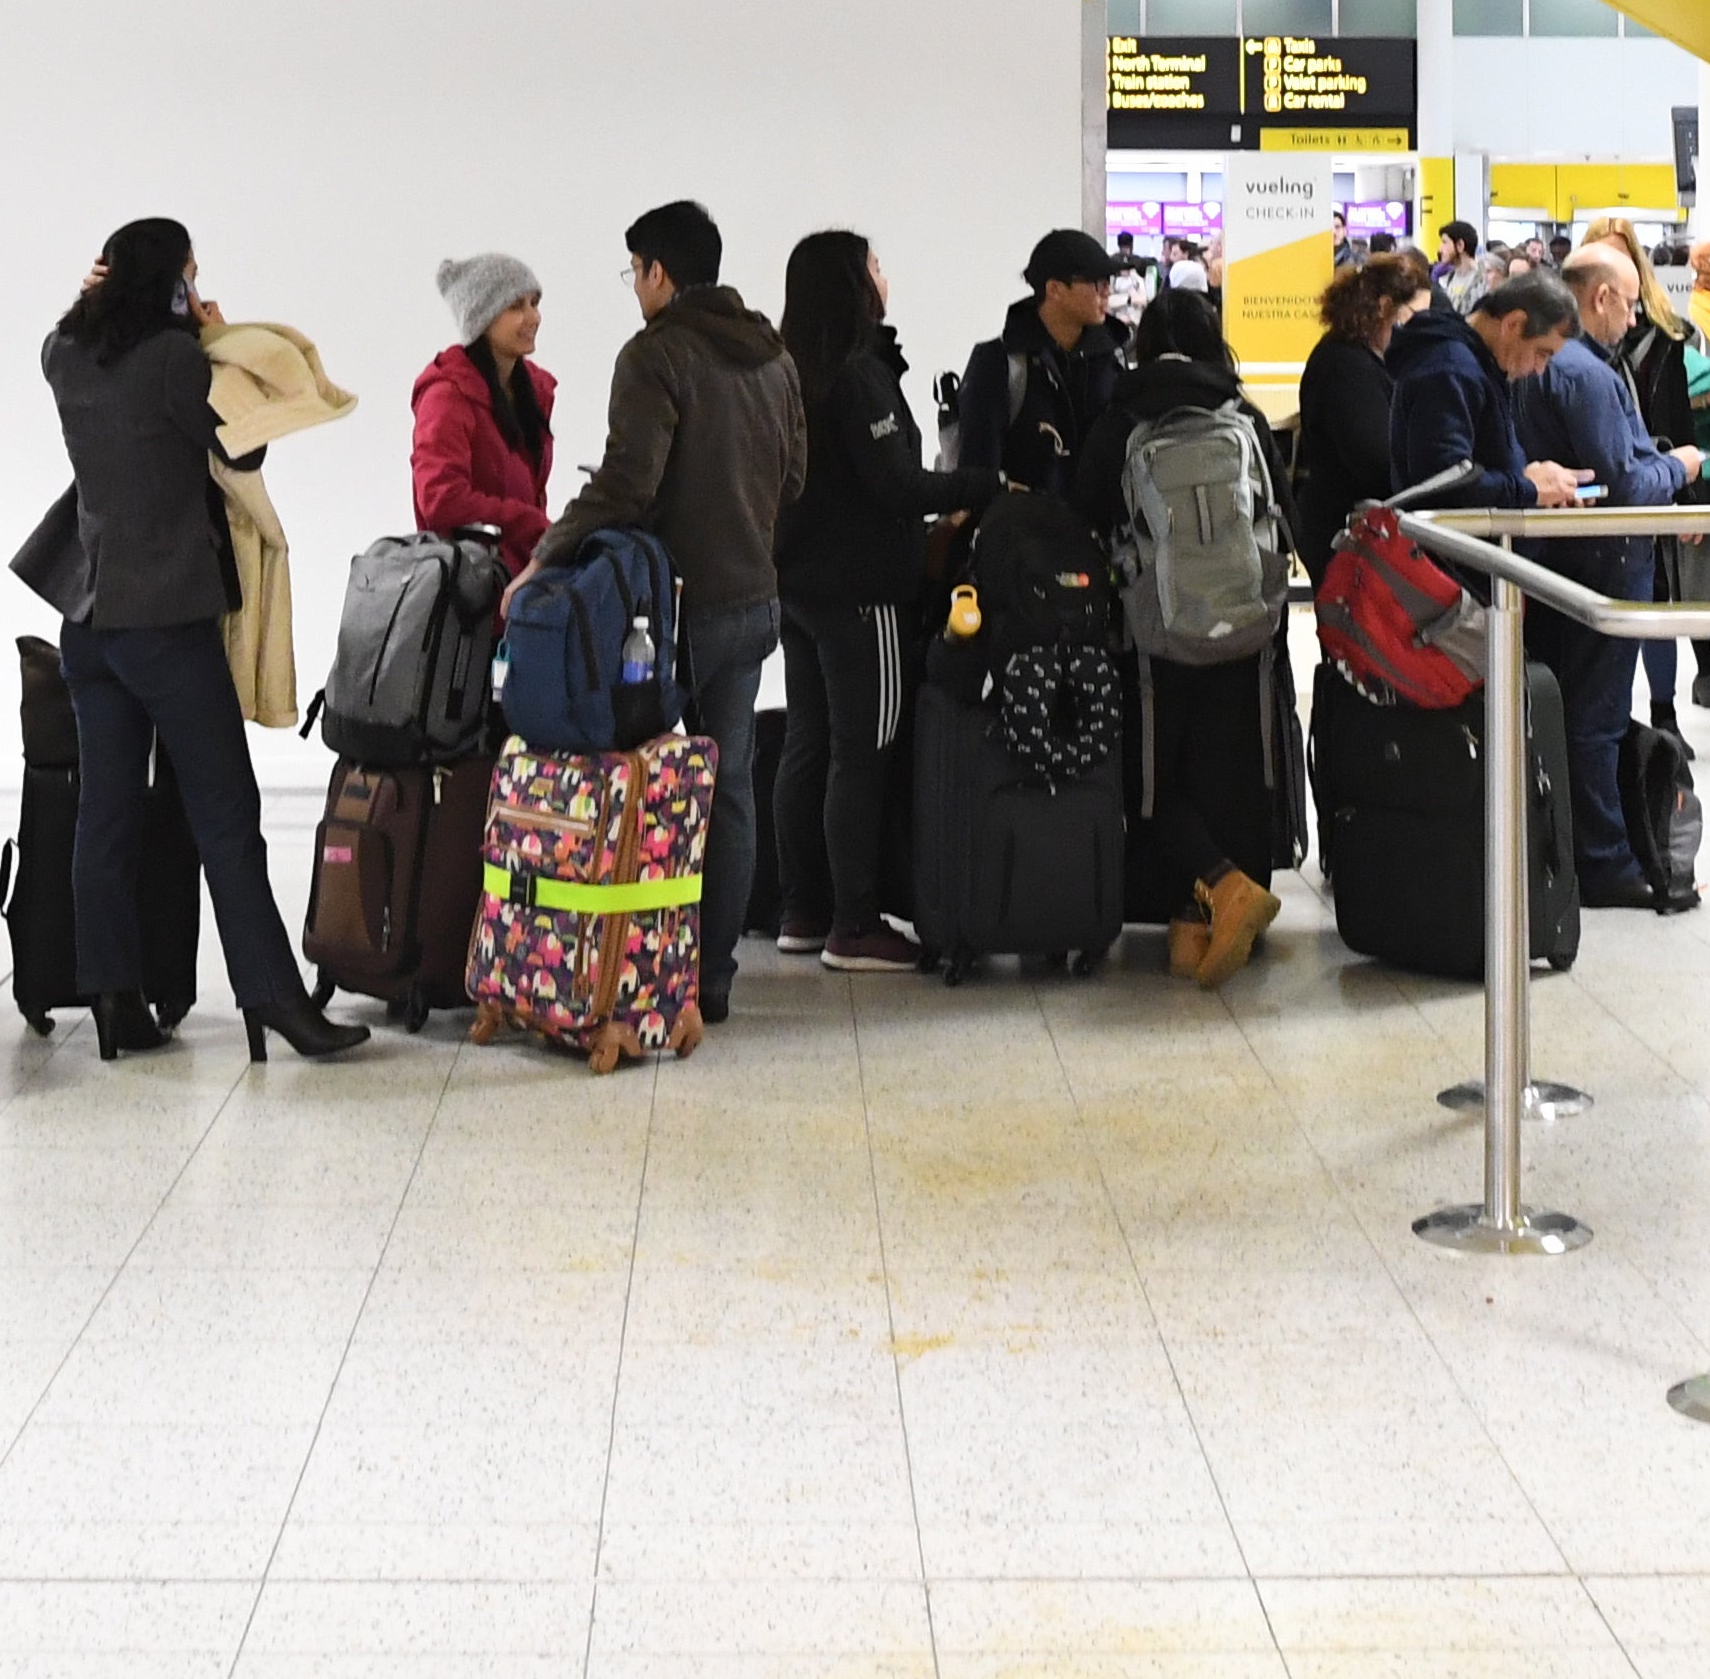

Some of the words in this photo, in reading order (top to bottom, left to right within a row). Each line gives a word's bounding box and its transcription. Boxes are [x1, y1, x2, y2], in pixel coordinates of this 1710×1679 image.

[1112, 36, 1137, 54] Exit
[1283, 37, 1316, 54] Taxis
[1112, 54, 1150, 72] North
[1151, 54, 1206, 72] Terminal
[1283, 55, 1306, 73] Car
[1307, 55, 1342, 74] parks
[1112, 73, 1144, 90] Train
[1146, 73, 1190, 90] station
[1283, 74, 1316, 91] Valet
[1317, 74, 1367, 94] parking
[1112, 91, 1205, 109] Buses/coaches
[1283, 92, 1306, 109] Car
[1307, 92, 1346, 109] rental
[1291, 133, 1331, 146] Toilets
[1245, 176, 1314, 200] vueling
[1245, 206, 1315, 220] CHECK-IN
[1242, 309, 1291, 320] NUESTRA
